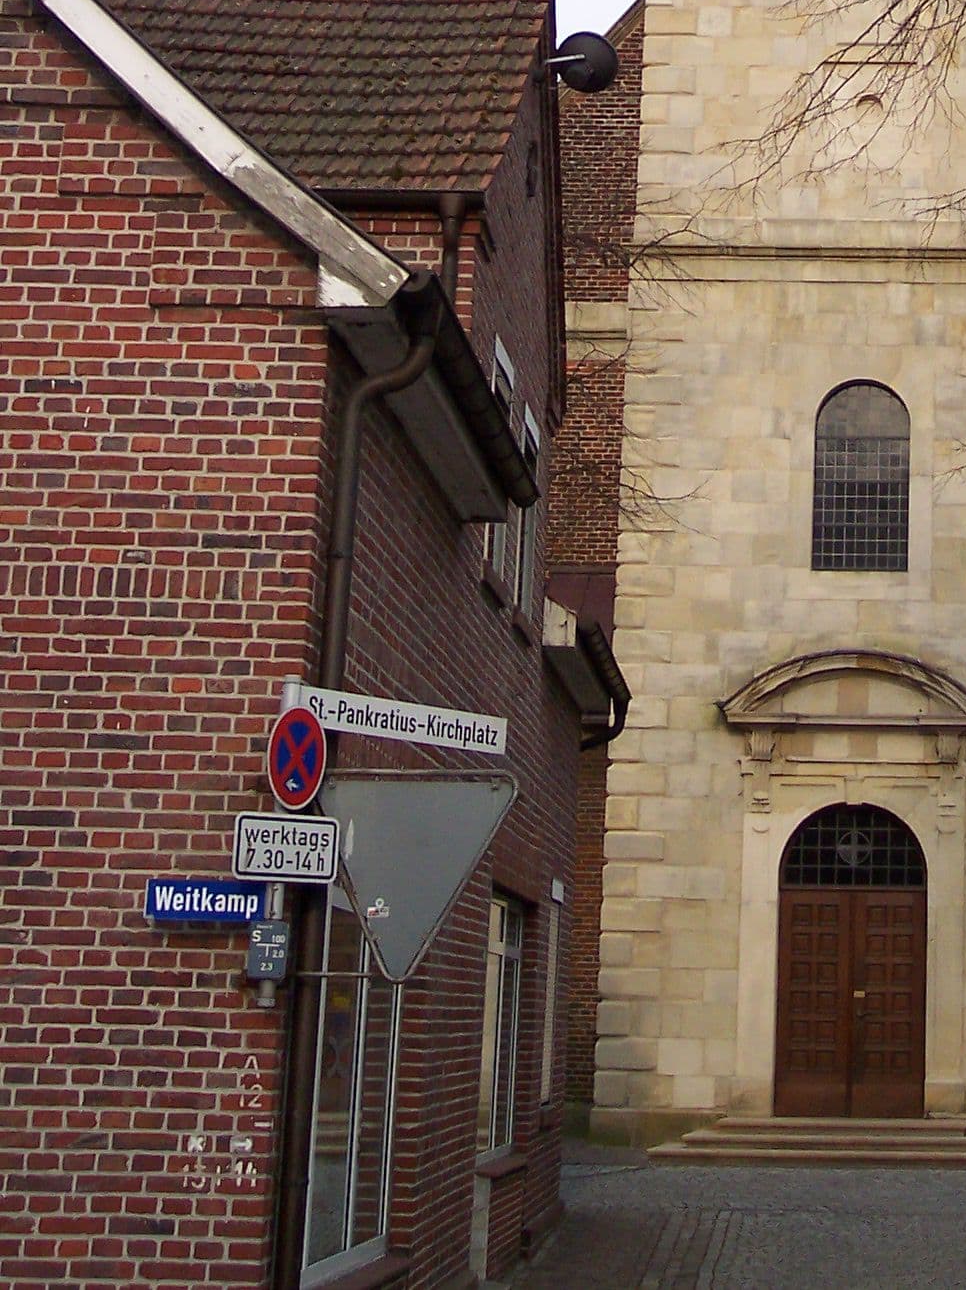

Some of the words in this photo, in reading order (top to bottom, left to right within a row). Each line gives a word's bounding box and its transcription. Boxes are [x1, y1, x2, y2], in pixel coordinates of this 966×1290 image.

[309, 695, 499, 747] St.-Pankratius-Kirchplatz
[244, 825, 330, 852] werktags
[244, 848, 312, 871] 7.30-14
[317, 851, 325, 872] h
[154, 884, 259, 920] Weitkamp
